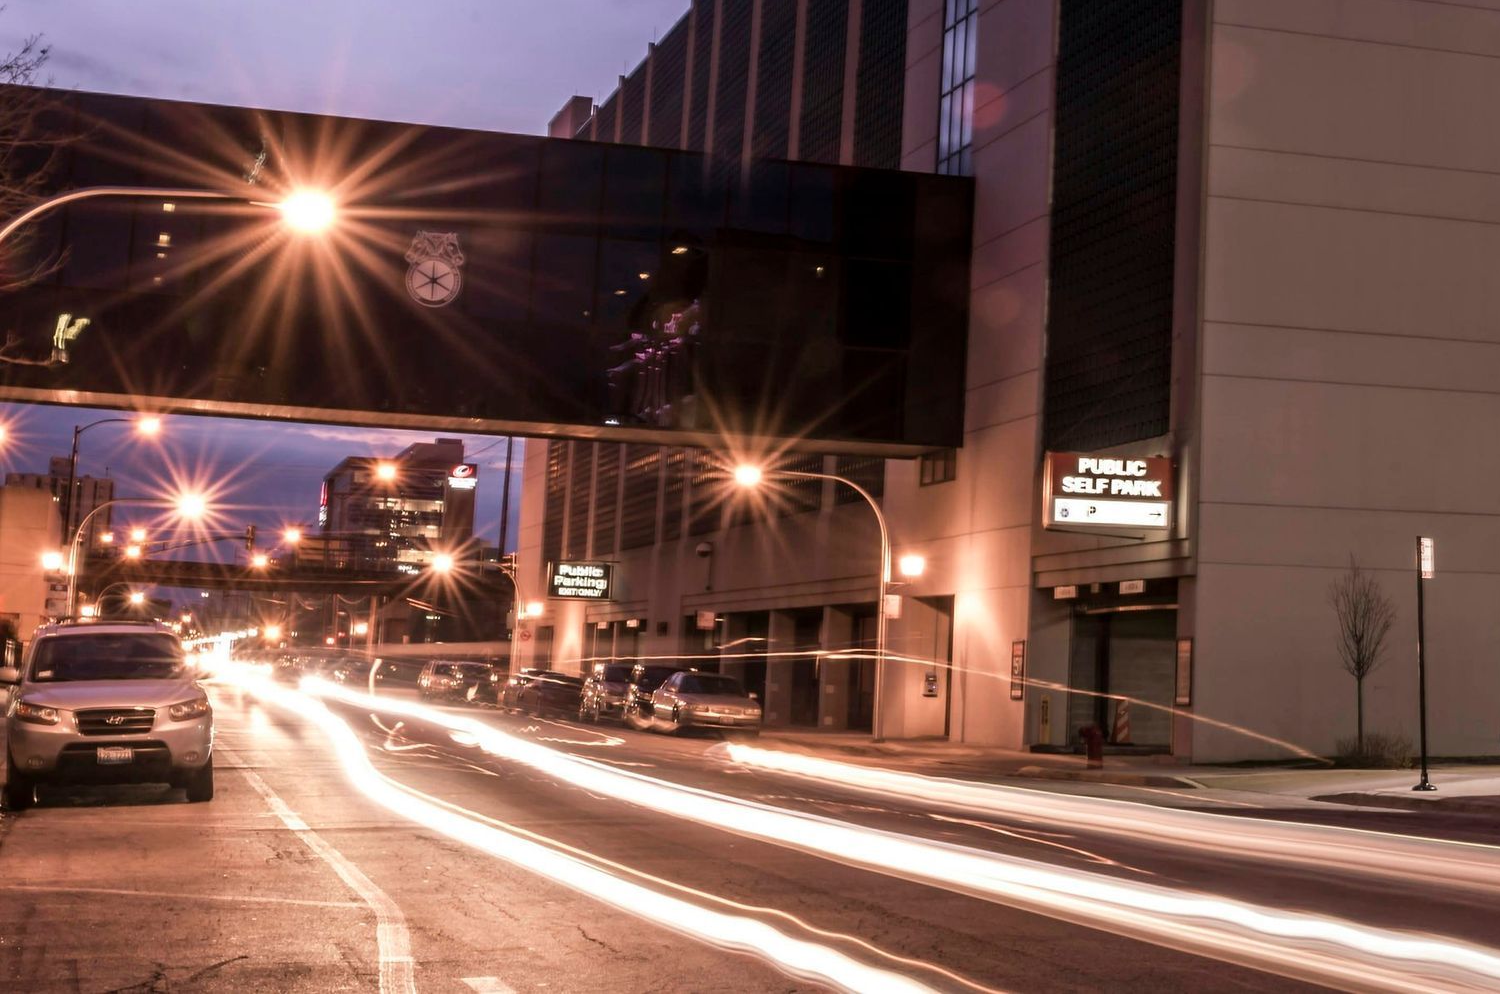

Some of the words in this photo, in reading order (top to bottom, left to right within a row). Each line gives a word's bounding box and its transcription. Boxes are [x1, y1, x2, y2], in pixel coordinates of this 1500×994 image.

[1078, 457, 1147, 477] PUBLIC
[1062, 476, 1109, 494] SELF
[1110, 479, 1162, 497] PARK
[559, 564, 604, 577] Public
[554, 575, 607, 590] Parking
[558, 587, 577, 596] EXIT
